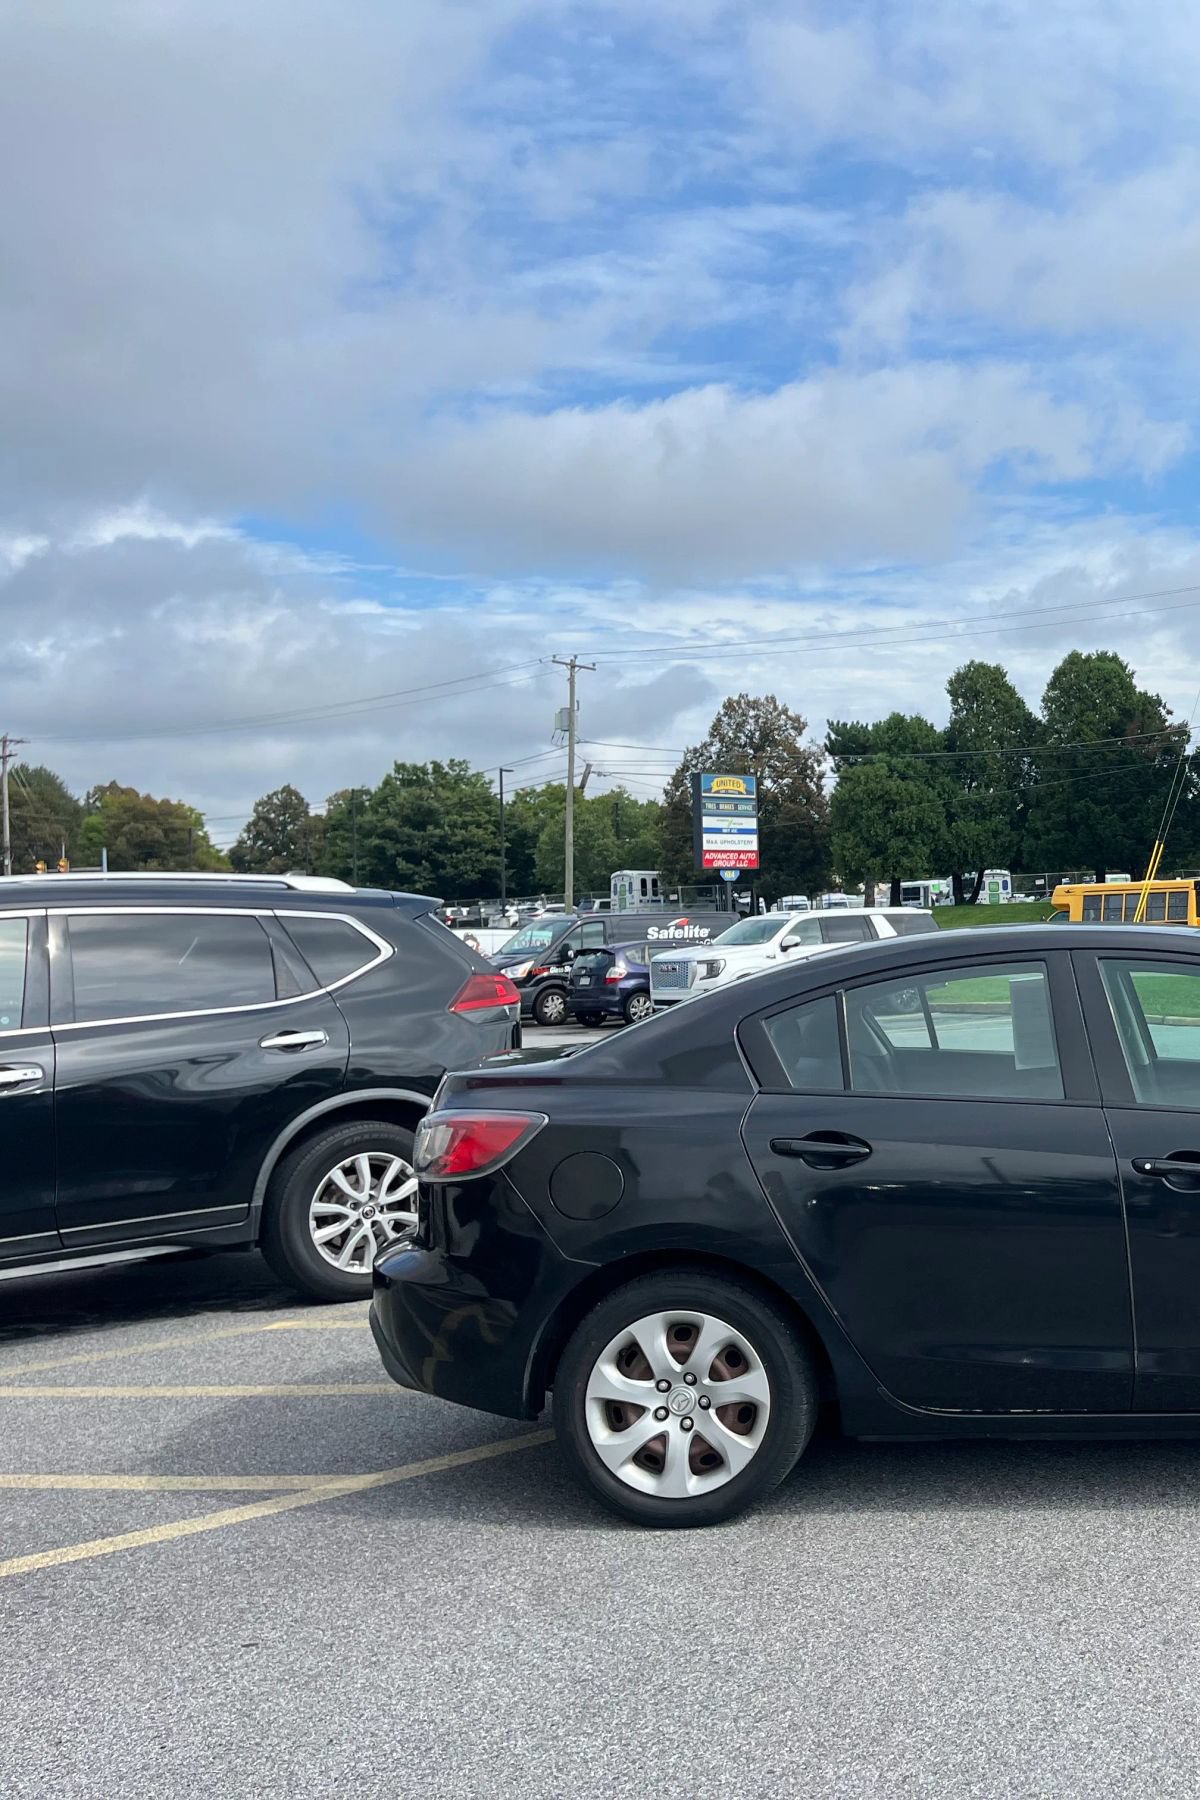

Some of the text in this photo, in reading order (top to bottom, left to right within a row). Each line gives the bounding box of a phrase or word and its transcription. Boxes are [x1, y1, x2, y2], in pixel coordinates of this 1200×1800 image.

[716, 780, 741, 788] UNITED
[705, 852, 738, 860] ADVANCED
[647, 925, 710, 940] Safelite
